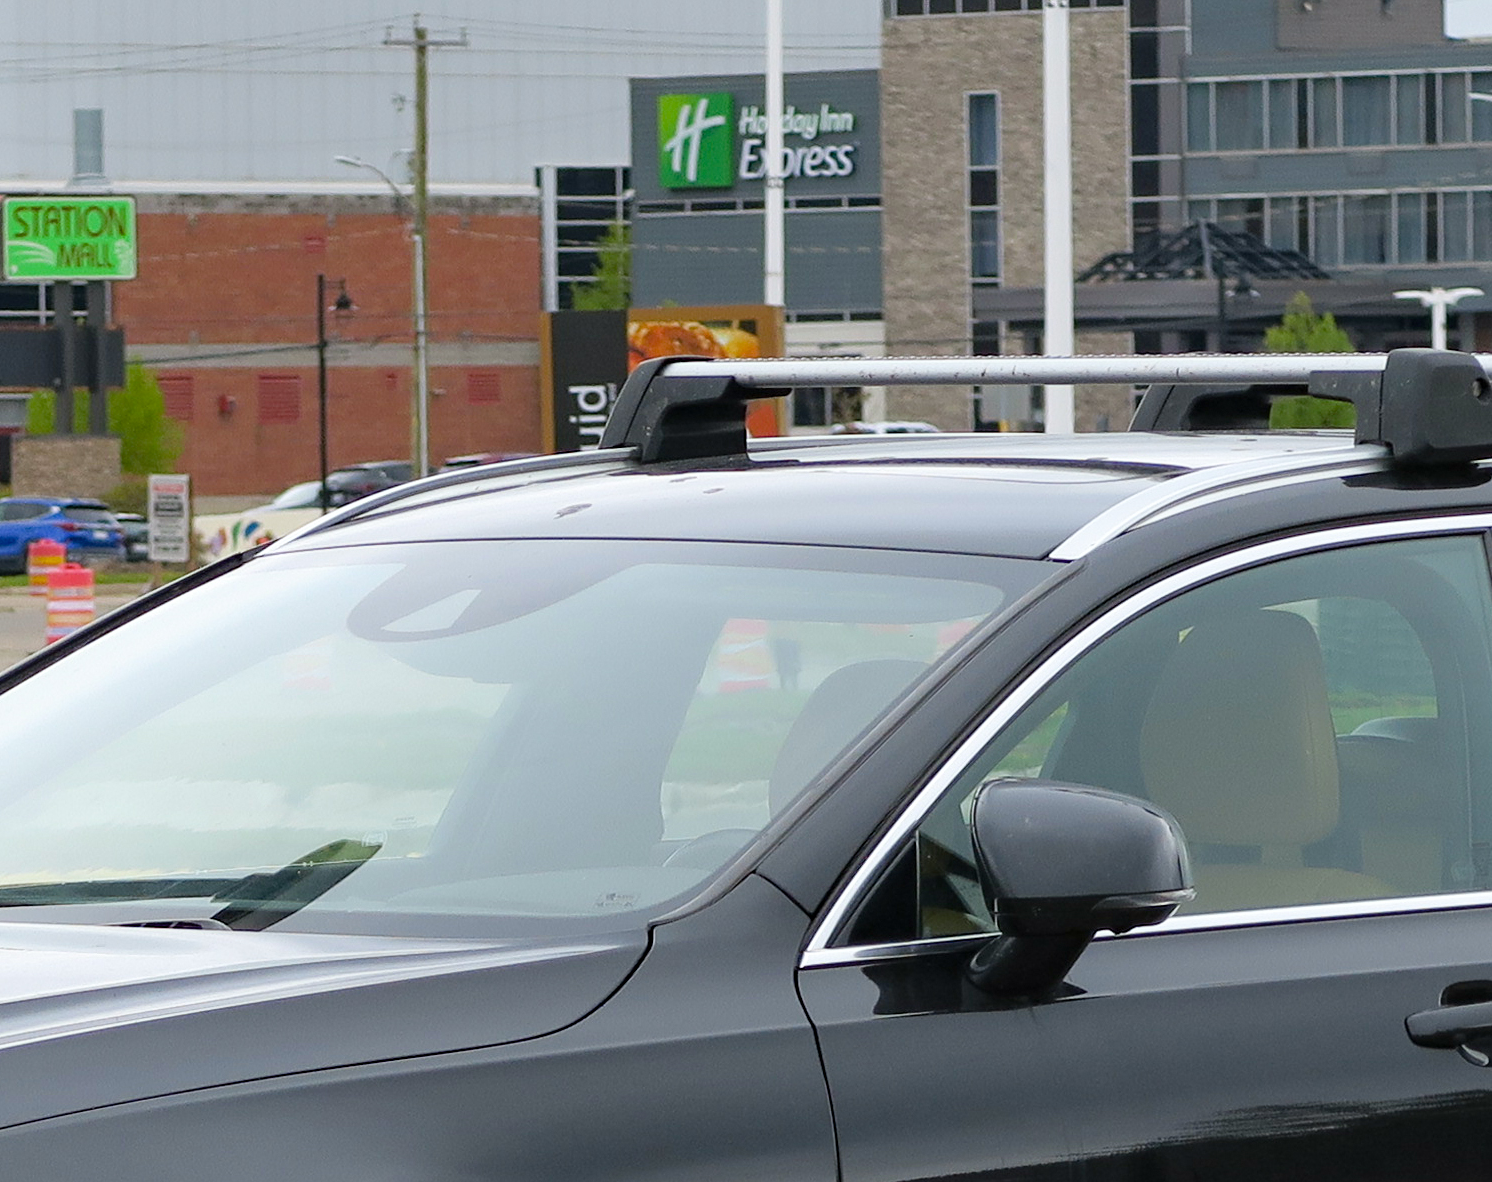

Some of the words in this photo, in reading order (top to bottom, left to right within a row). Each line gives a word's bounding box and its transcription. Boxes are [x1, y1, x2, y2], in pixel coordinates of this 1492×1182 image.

[738, 105, 819, 140] Hoday
[820, 103, 854, 132] Inn
[13, 205, 127, 238] STATION
[57, 243, 115, 268] MALL
